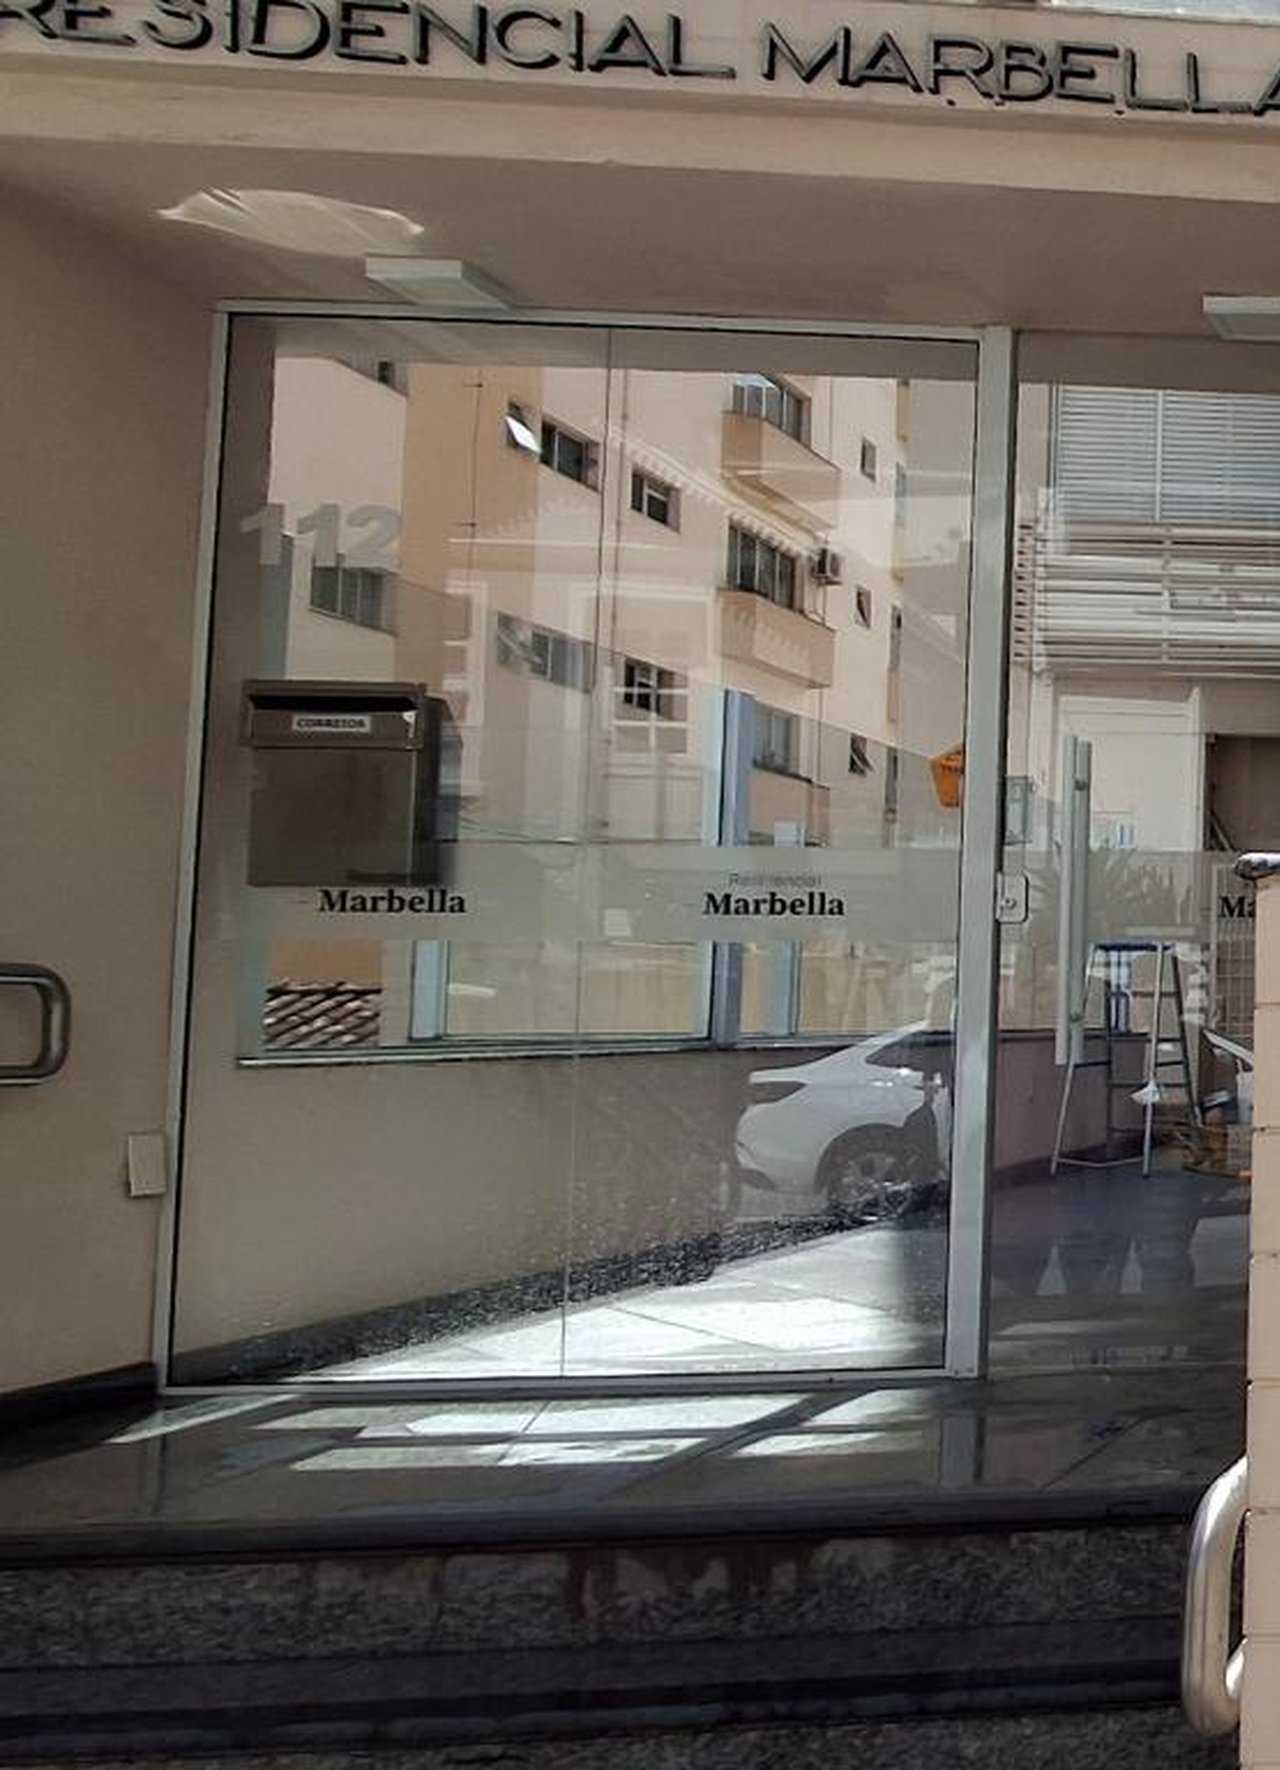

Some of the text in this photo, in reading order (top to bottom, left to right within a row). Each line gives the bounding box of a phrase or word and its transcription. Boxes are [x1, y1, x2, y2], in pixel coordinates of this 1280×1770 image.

[241, 503, 401, 568] 112
[318, 889, 466, 914] Marbella
[702, 891, 845, 916] Marbella
